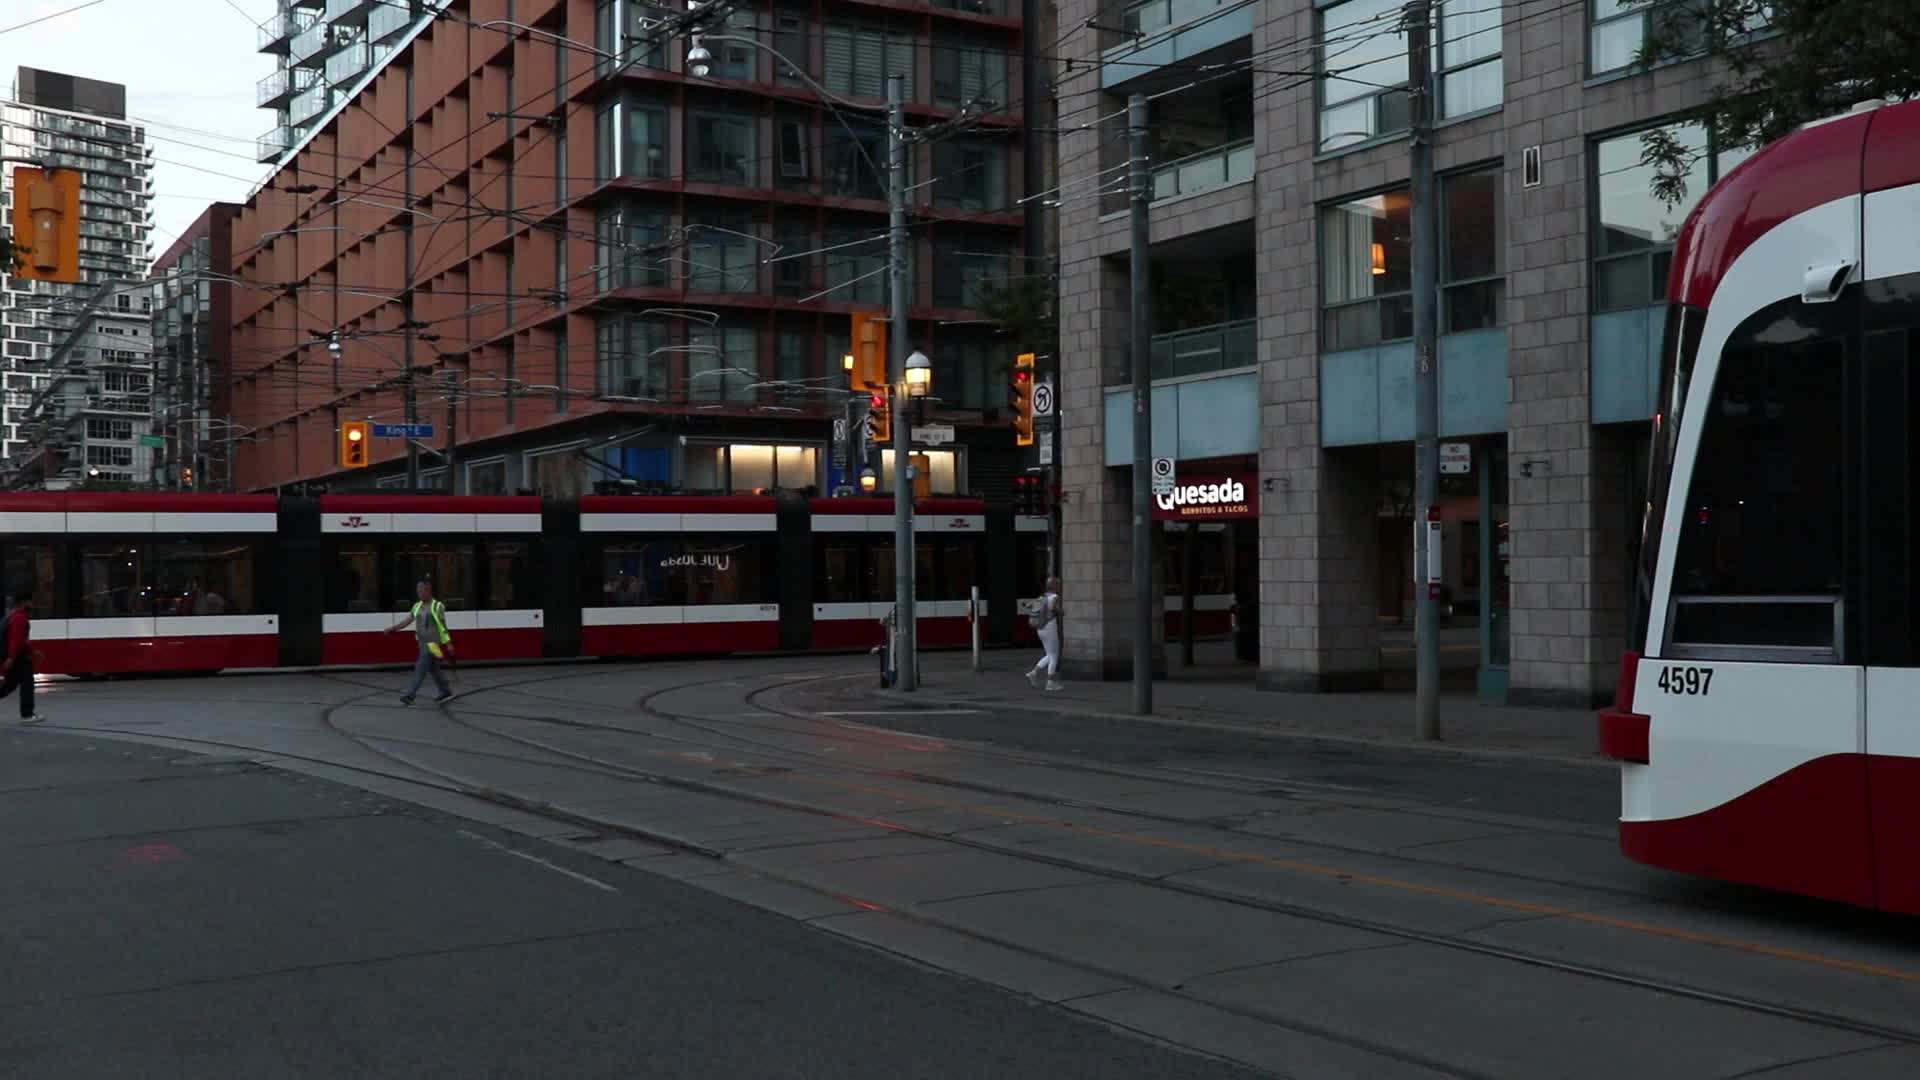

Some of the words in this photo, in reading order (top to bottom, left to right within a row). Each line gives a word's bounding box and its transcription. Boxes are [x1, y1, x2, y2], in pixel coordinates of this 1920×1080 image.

[386, 426, 406, 436] King
[415, 426, 422, 435] E
[1156, 477, 1245, 510] Quesada
[1225, 505, 1249, 513] TACOS
[1658, 666, 1713, 695] 4597
